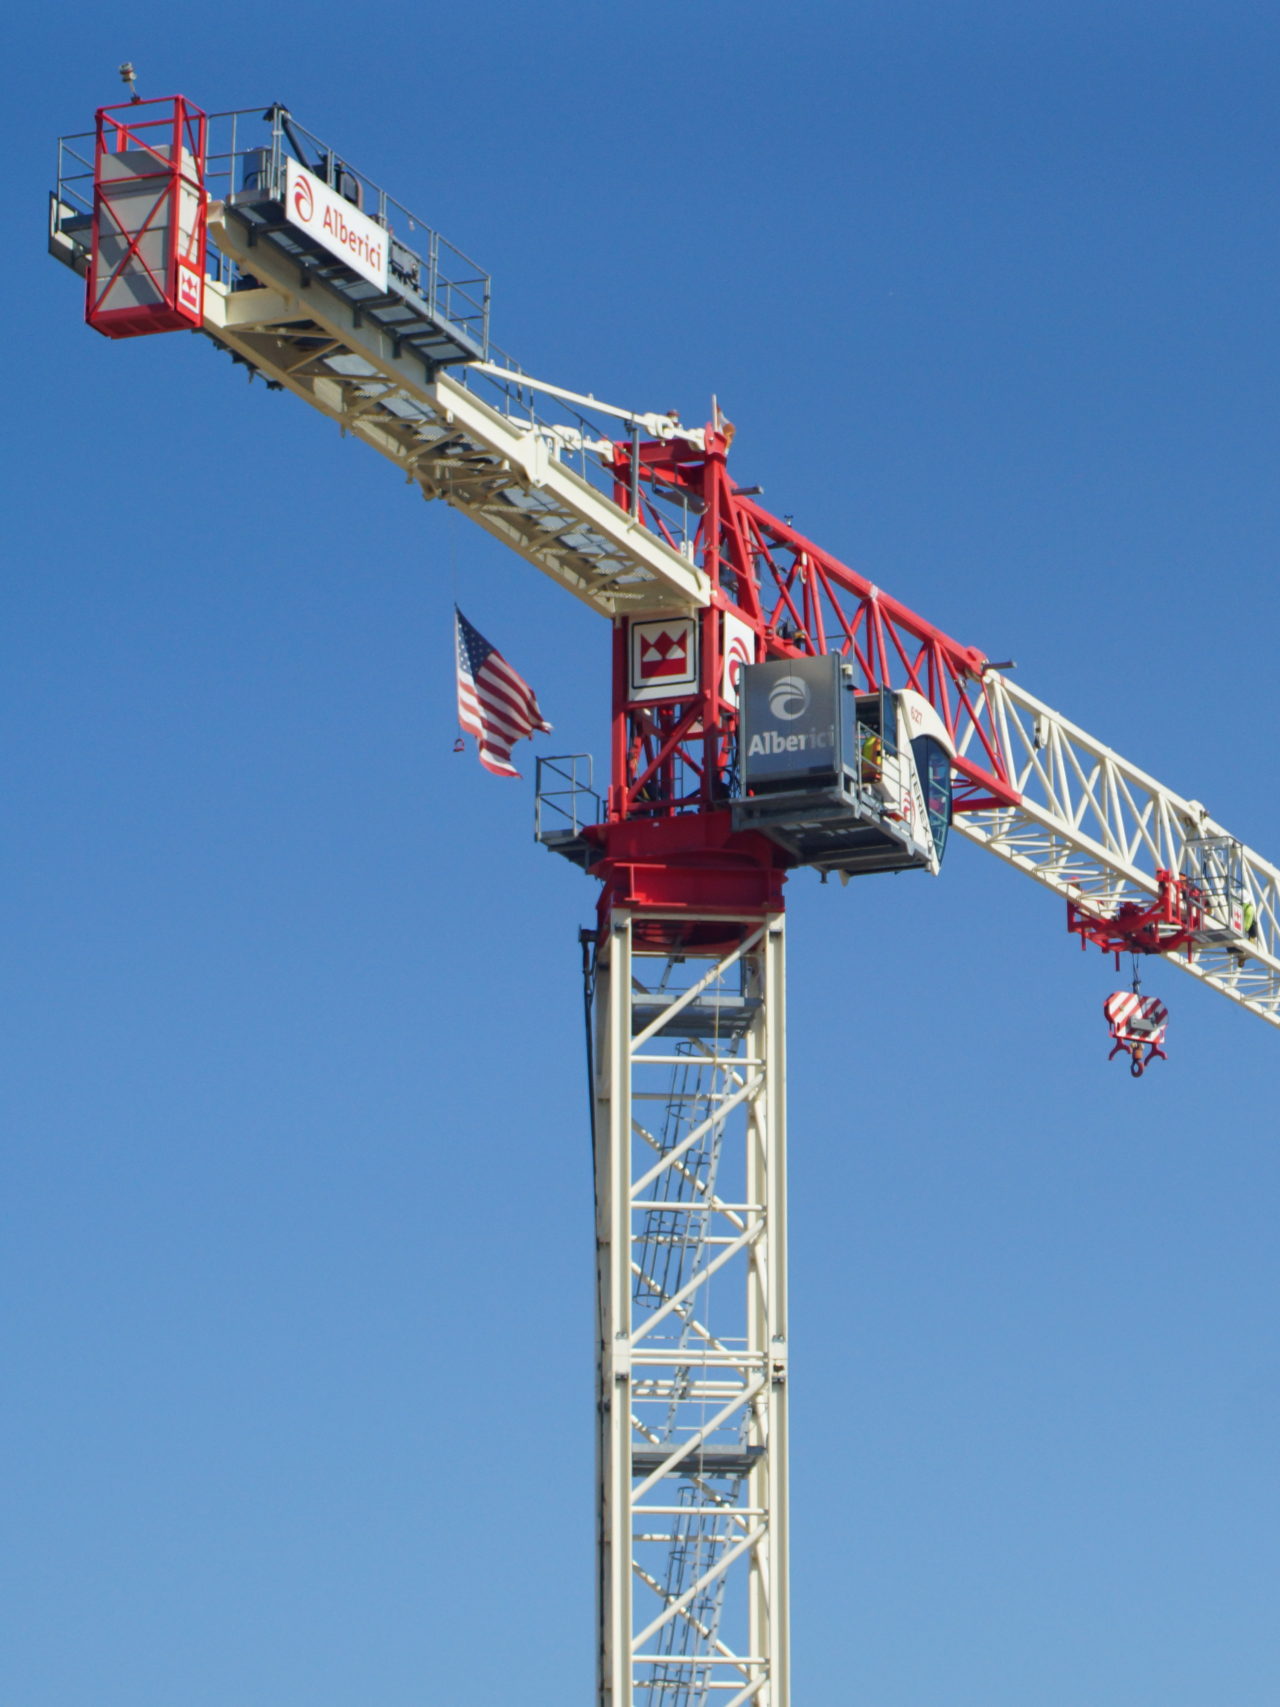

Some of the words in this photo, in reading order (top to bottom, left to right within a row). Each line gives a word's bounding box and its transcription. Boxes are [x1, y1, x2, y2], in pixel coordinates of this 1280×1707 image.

[323, 204, 381, 272] Alberici
[911, 705, 922, 725] 627
[748, 724, 834, 756] Alberici
